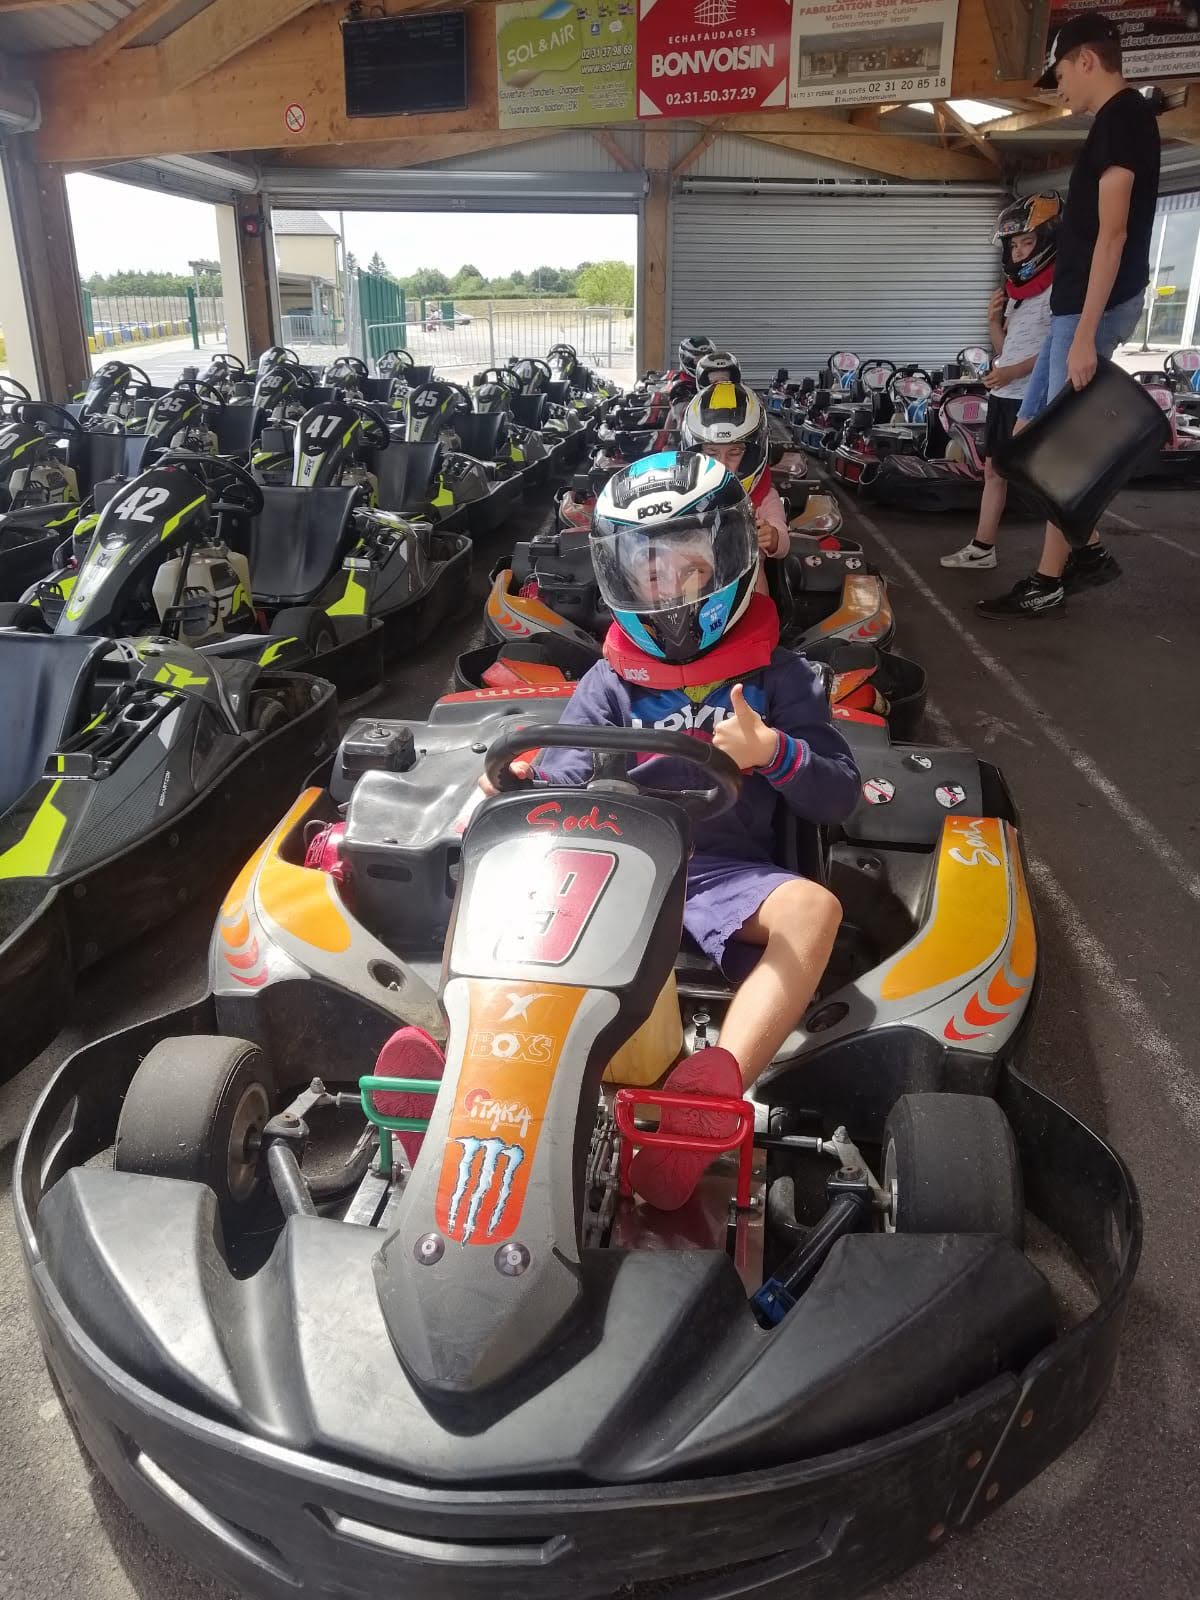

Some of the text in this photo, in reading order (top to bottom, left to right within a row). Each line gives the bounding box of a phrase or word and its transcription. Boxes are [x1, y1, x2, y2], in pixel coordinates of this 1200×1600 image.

[800, 1, 873, 16] FABRICATION
[668, 28, 756, 44] ECHAFAUDAGES
[506, 41, 538, 67] SOL
[538, 39, 548, 52] &
[581, 48, 590, 59] 02
[592, 47, 600, 57] 31
[602, 46, 611, 57] 37
[623, 44, 633, 55] 69
[651, 44, 775, 78] BONVOISIN
[868, 77, 946, 93] 02 31 20 85 18
[665, 87, 757, 105] 02.31.50.37.29
[158, 397, 187, 413] 35
[414, 390, 438, 408] 45
[305, 415, 342, 438] 47
[114, 486, 170, 524] 42
[528, 801, 624, 836] Sodi
